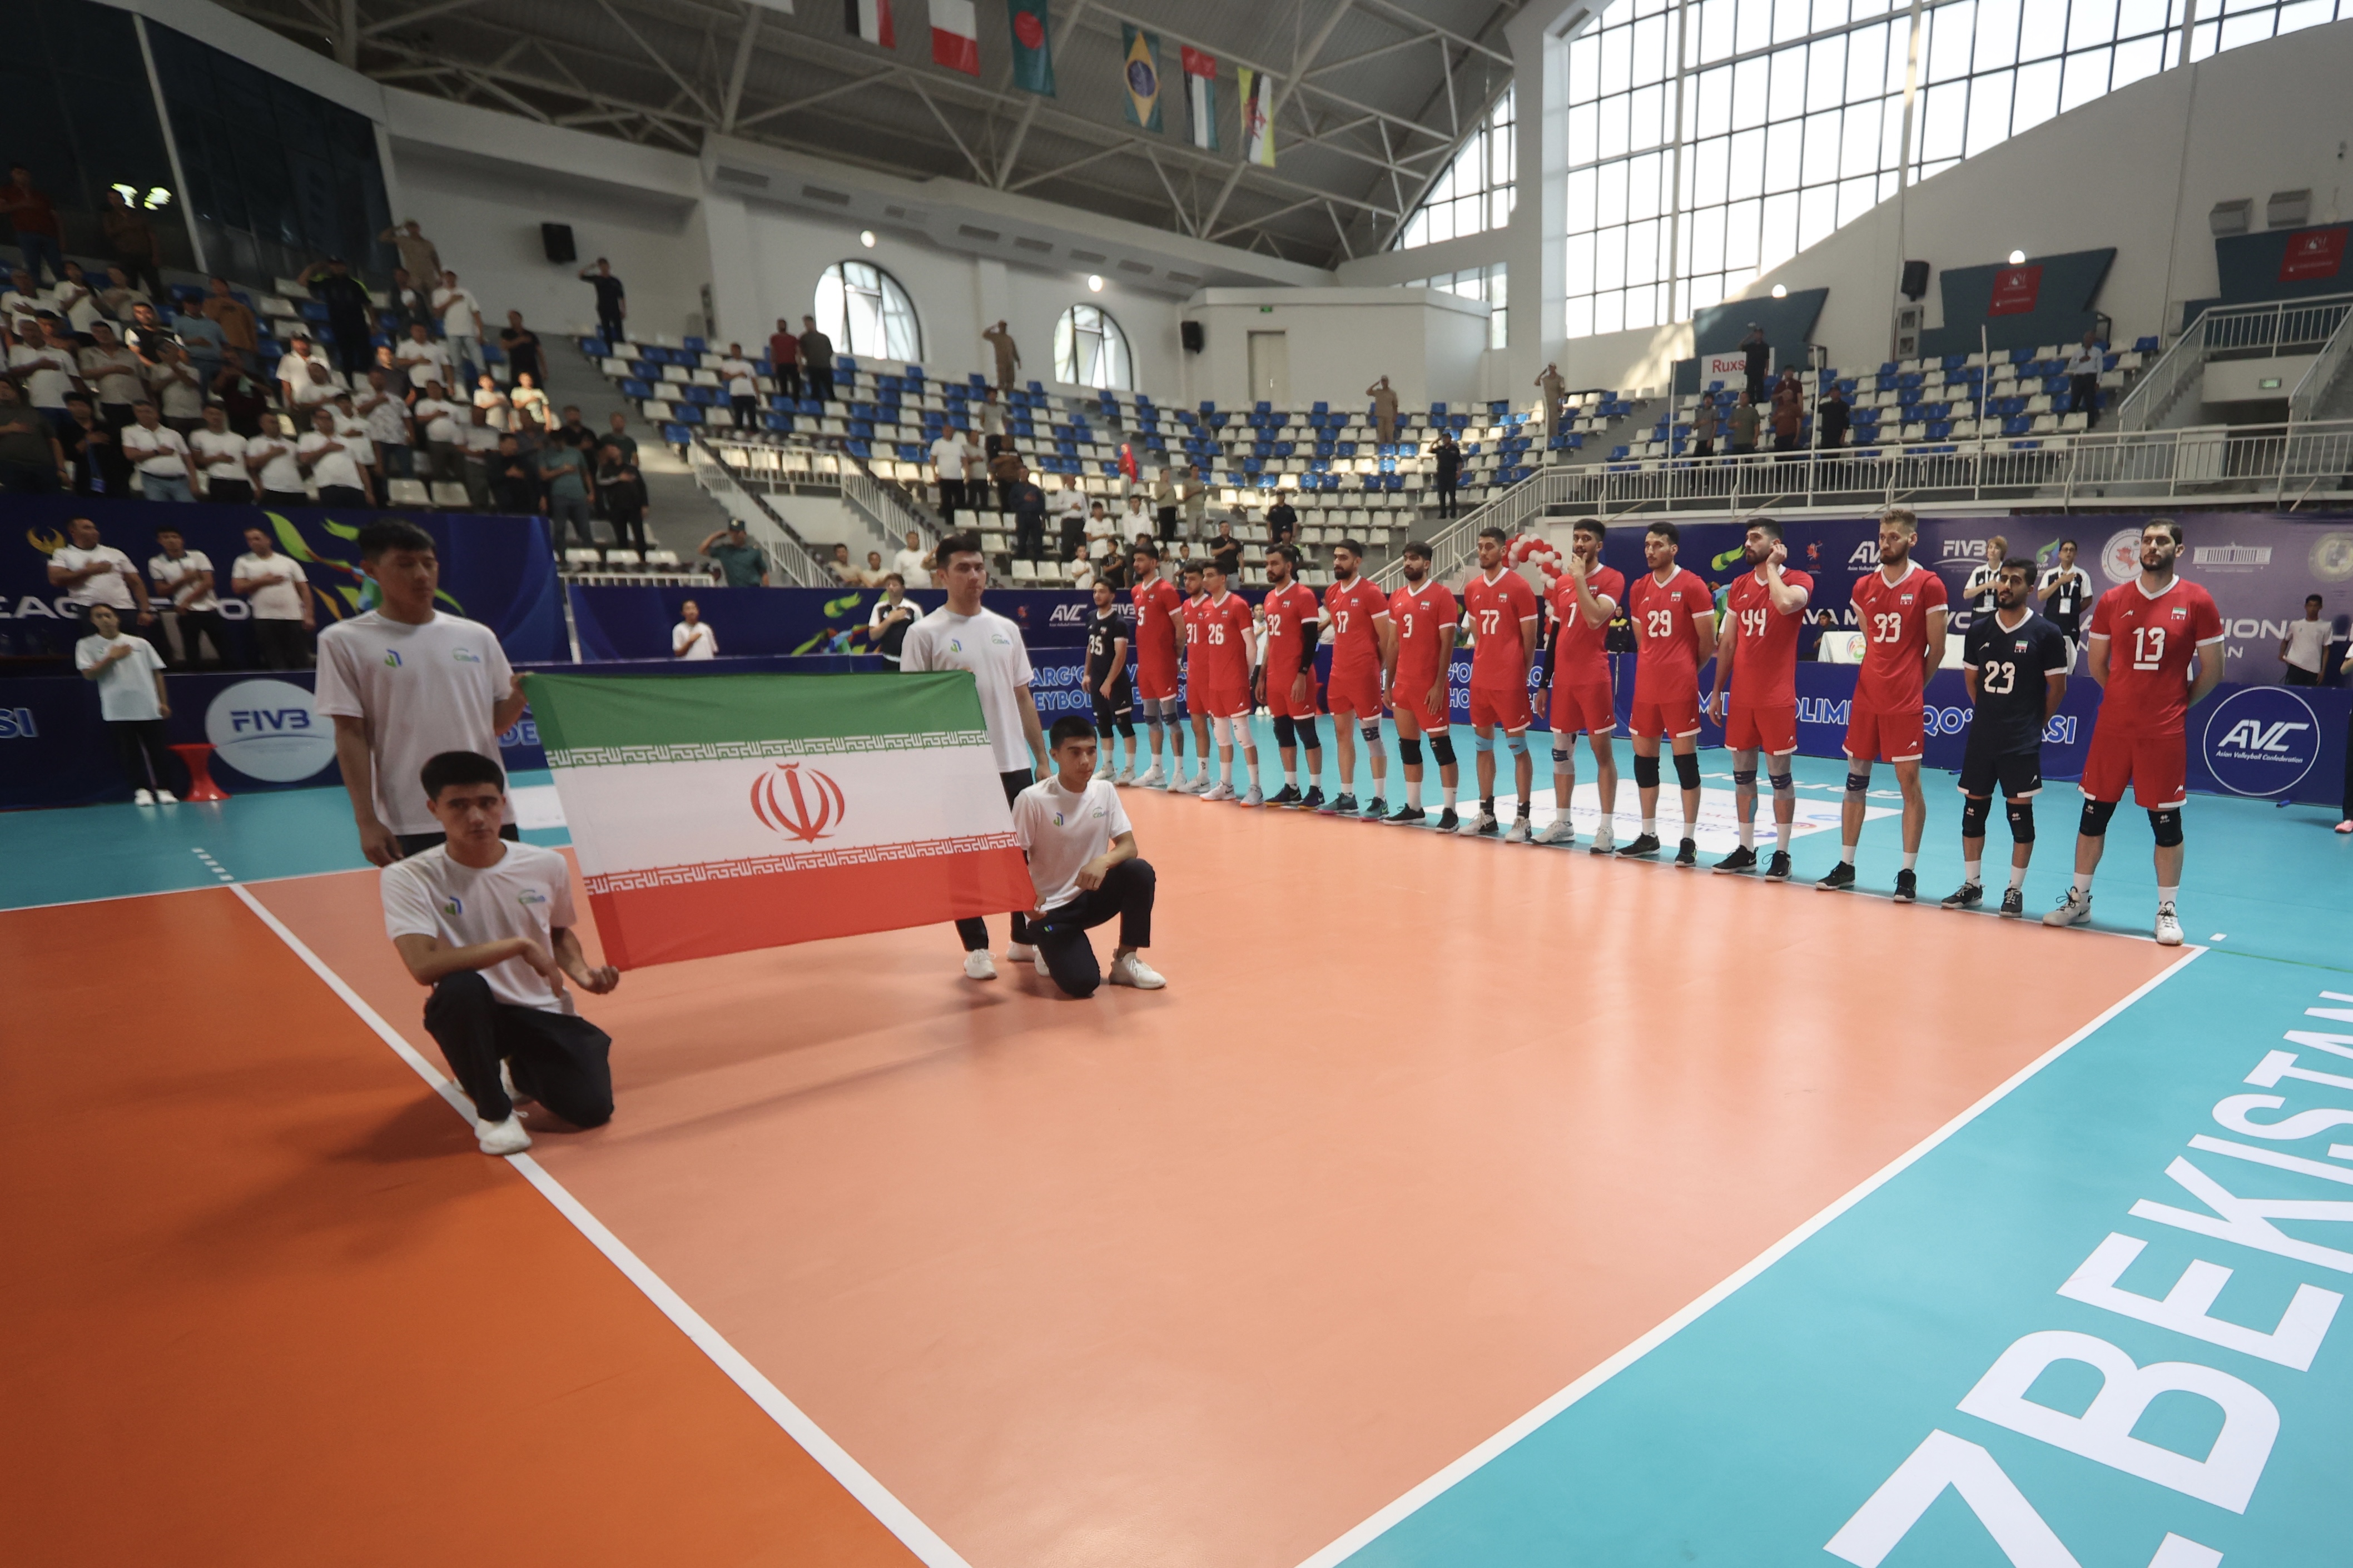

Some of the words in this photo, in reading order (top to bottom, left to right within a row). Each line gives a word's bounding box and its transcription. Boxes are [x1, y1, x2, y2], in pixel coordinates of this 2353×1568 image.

[1943, 540, 1986, 557] FIVB
[1049, 604, 1088, 621] AVC
[1138, 606, 1145, 626] 5
[1480, 609, 1500, 635] 77
[1647, 610, 1671, 638] 29
[1741, 608, 1766, 636] 44
[1185, 623, 1197, 645] 31
[1208, 623, 1224, 645] 26
[1268, 614, 1280, 637] 32
[1403, 614, 1413, 638] 3
[1873, 612, 1902, 643] 33
[2133, 627, 2166, 662] 13
[1984, 660, 2016, 694] 23
[231, 709, 310, 732] FIVB
[2217, 719, 2310, 752] AVC
[2233, 752, 2262, 761] Volleyball
[2262, 754, 2303, 763] Confederation
